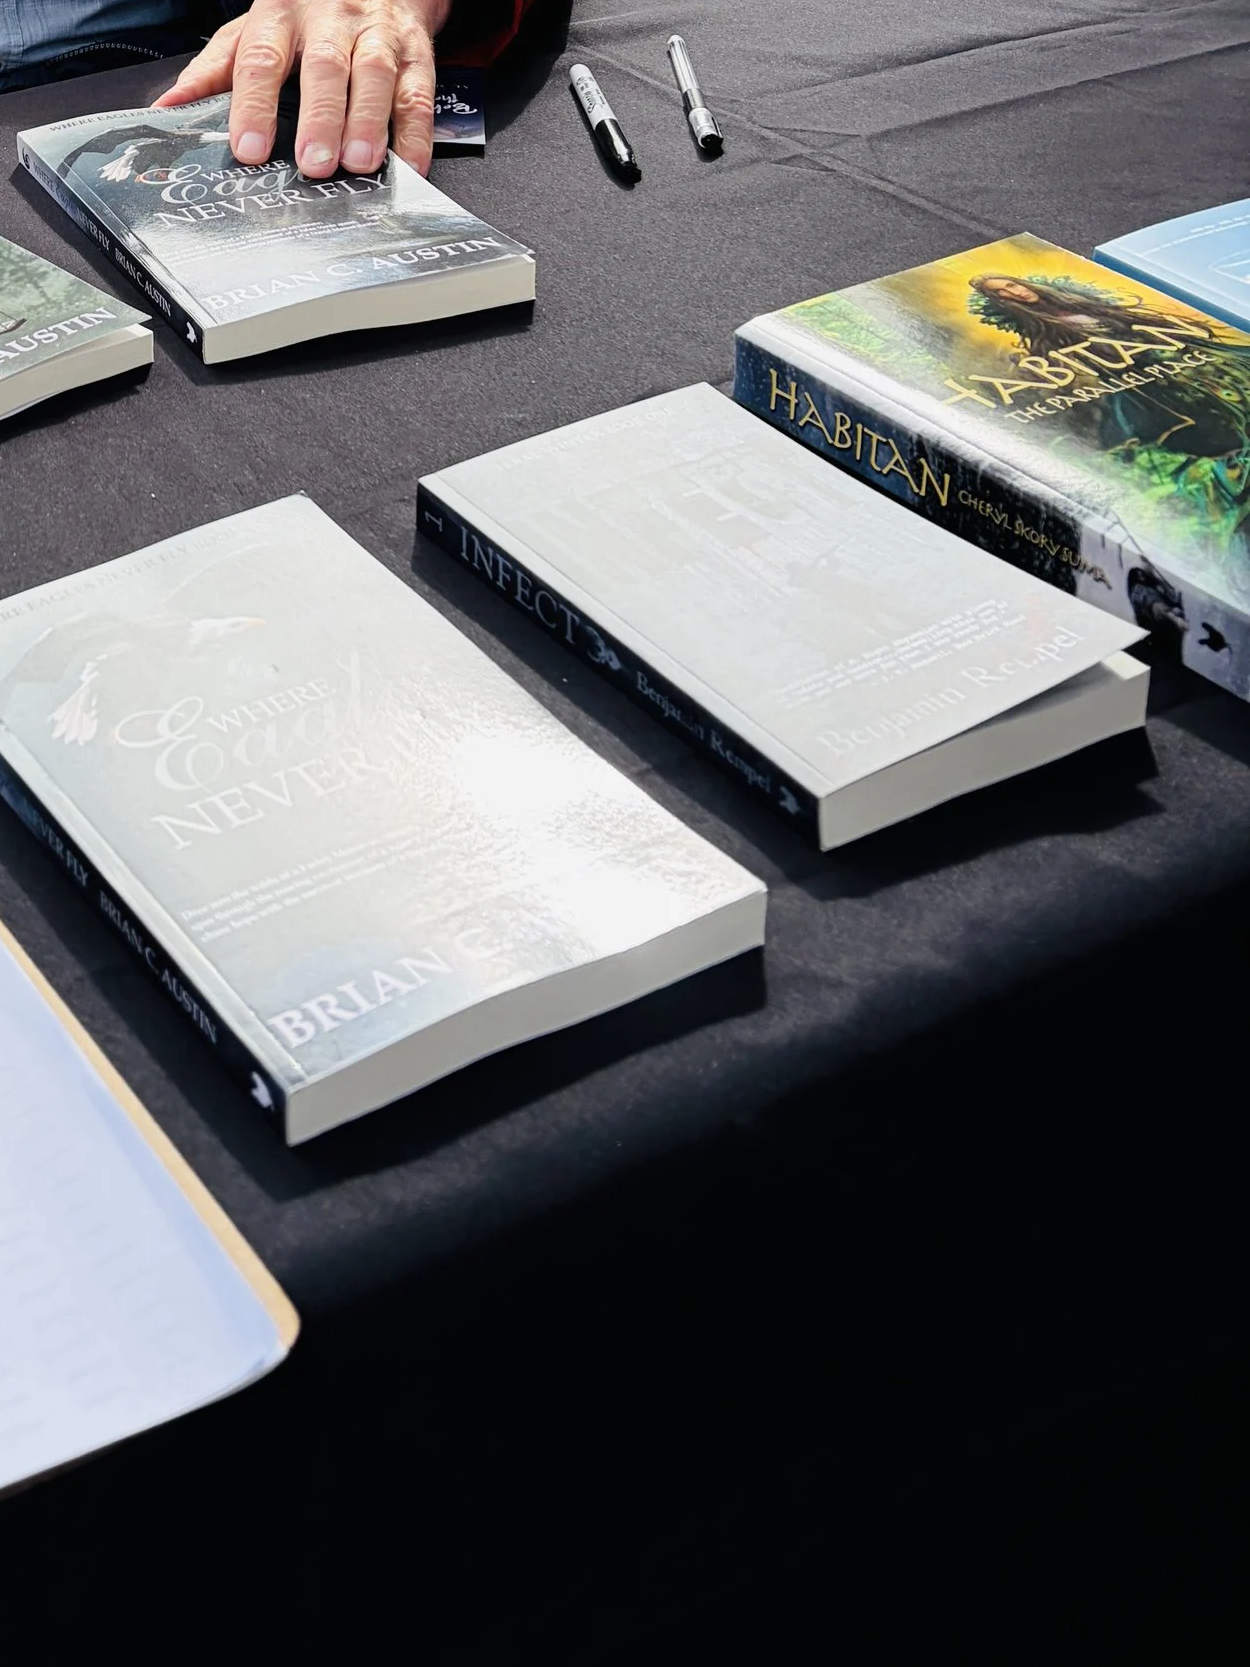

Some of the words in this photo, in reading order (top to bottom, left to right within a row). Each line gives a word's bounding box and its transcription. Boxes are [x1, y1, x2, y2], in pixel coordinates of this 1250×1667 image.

[153, 188, 314, 228] NEVER
[312, 174, 391, 200] FLY
[202, 160, 291, 183] WHERE
[76, 207, 99, 239] NEVER
[98, 230, 111, 251] FLY
[115, 248, 137, 280] BRIAN
[144, 282, 172, 317] AUSTIN
[201, 269, 321, 312] BRIAN
[326, 263, 363, 276] C.
[372, 236, 505, 271] AUSTIN
[942, 314, 1212, 409] HABITAN
[1004, 400, 1050, 425] THE
[1046, 369, 1157, 411] PARALLEL
[1154, 350, 1217, 379] PLACE
[768, 368, 952, 508] HABITAN
[958, 488, 1015, 531] CHERYL
[1014, 513, 1062, 558] SKORY
[1061, 544, 1115, 591] SUMA
[205, 677, 336, 734] WHERE
[150, 747, 390, 852] NEVER
[710, 731, 772, 793] Rempel
[65, 850, 90, 888] FLY
[99, 890, 143, 957] BRIAN
[161, 968, 218, 1045] AUSTIN
[266, 945, 453, 1050] BRIAN
